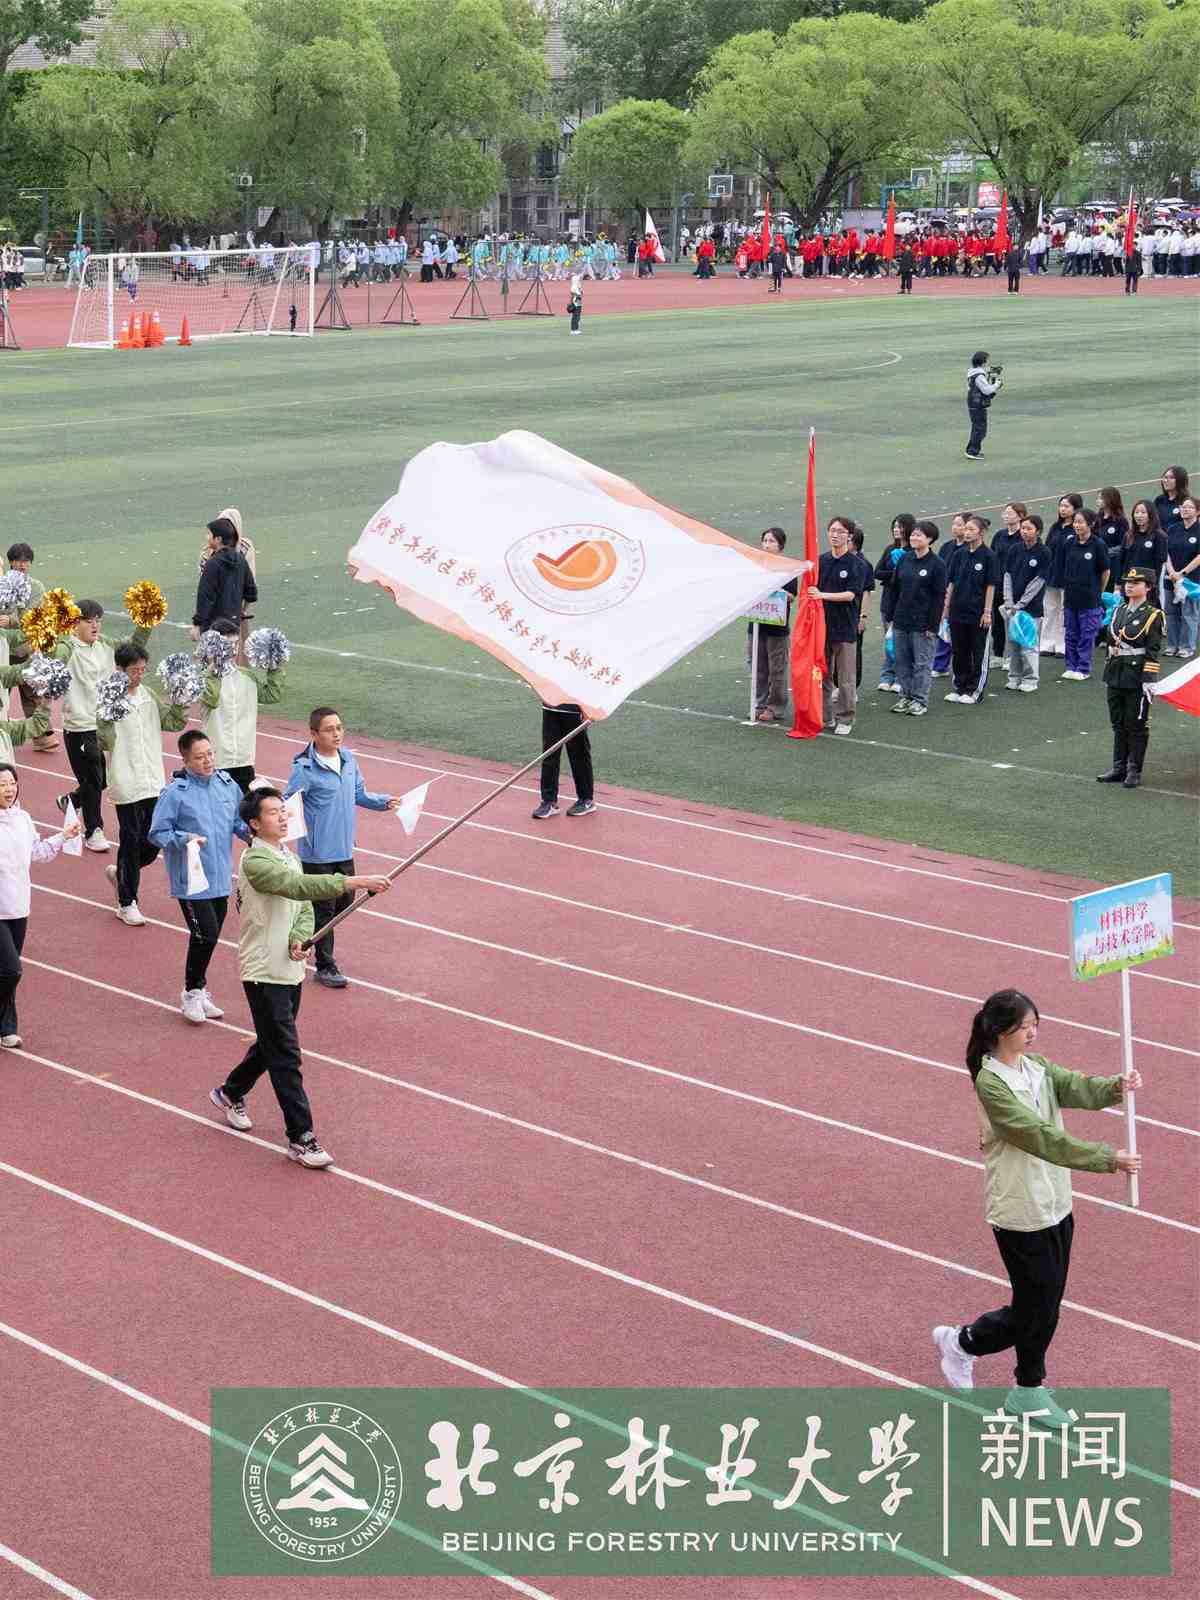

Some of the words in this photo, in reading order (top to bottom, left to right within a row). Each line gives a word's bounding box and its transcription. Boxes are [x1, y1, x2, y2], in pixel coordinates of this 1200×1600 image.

[1100, 901, 1149, 930] 材料科学
[1095, 921, 1157, 954] 与技术学院
